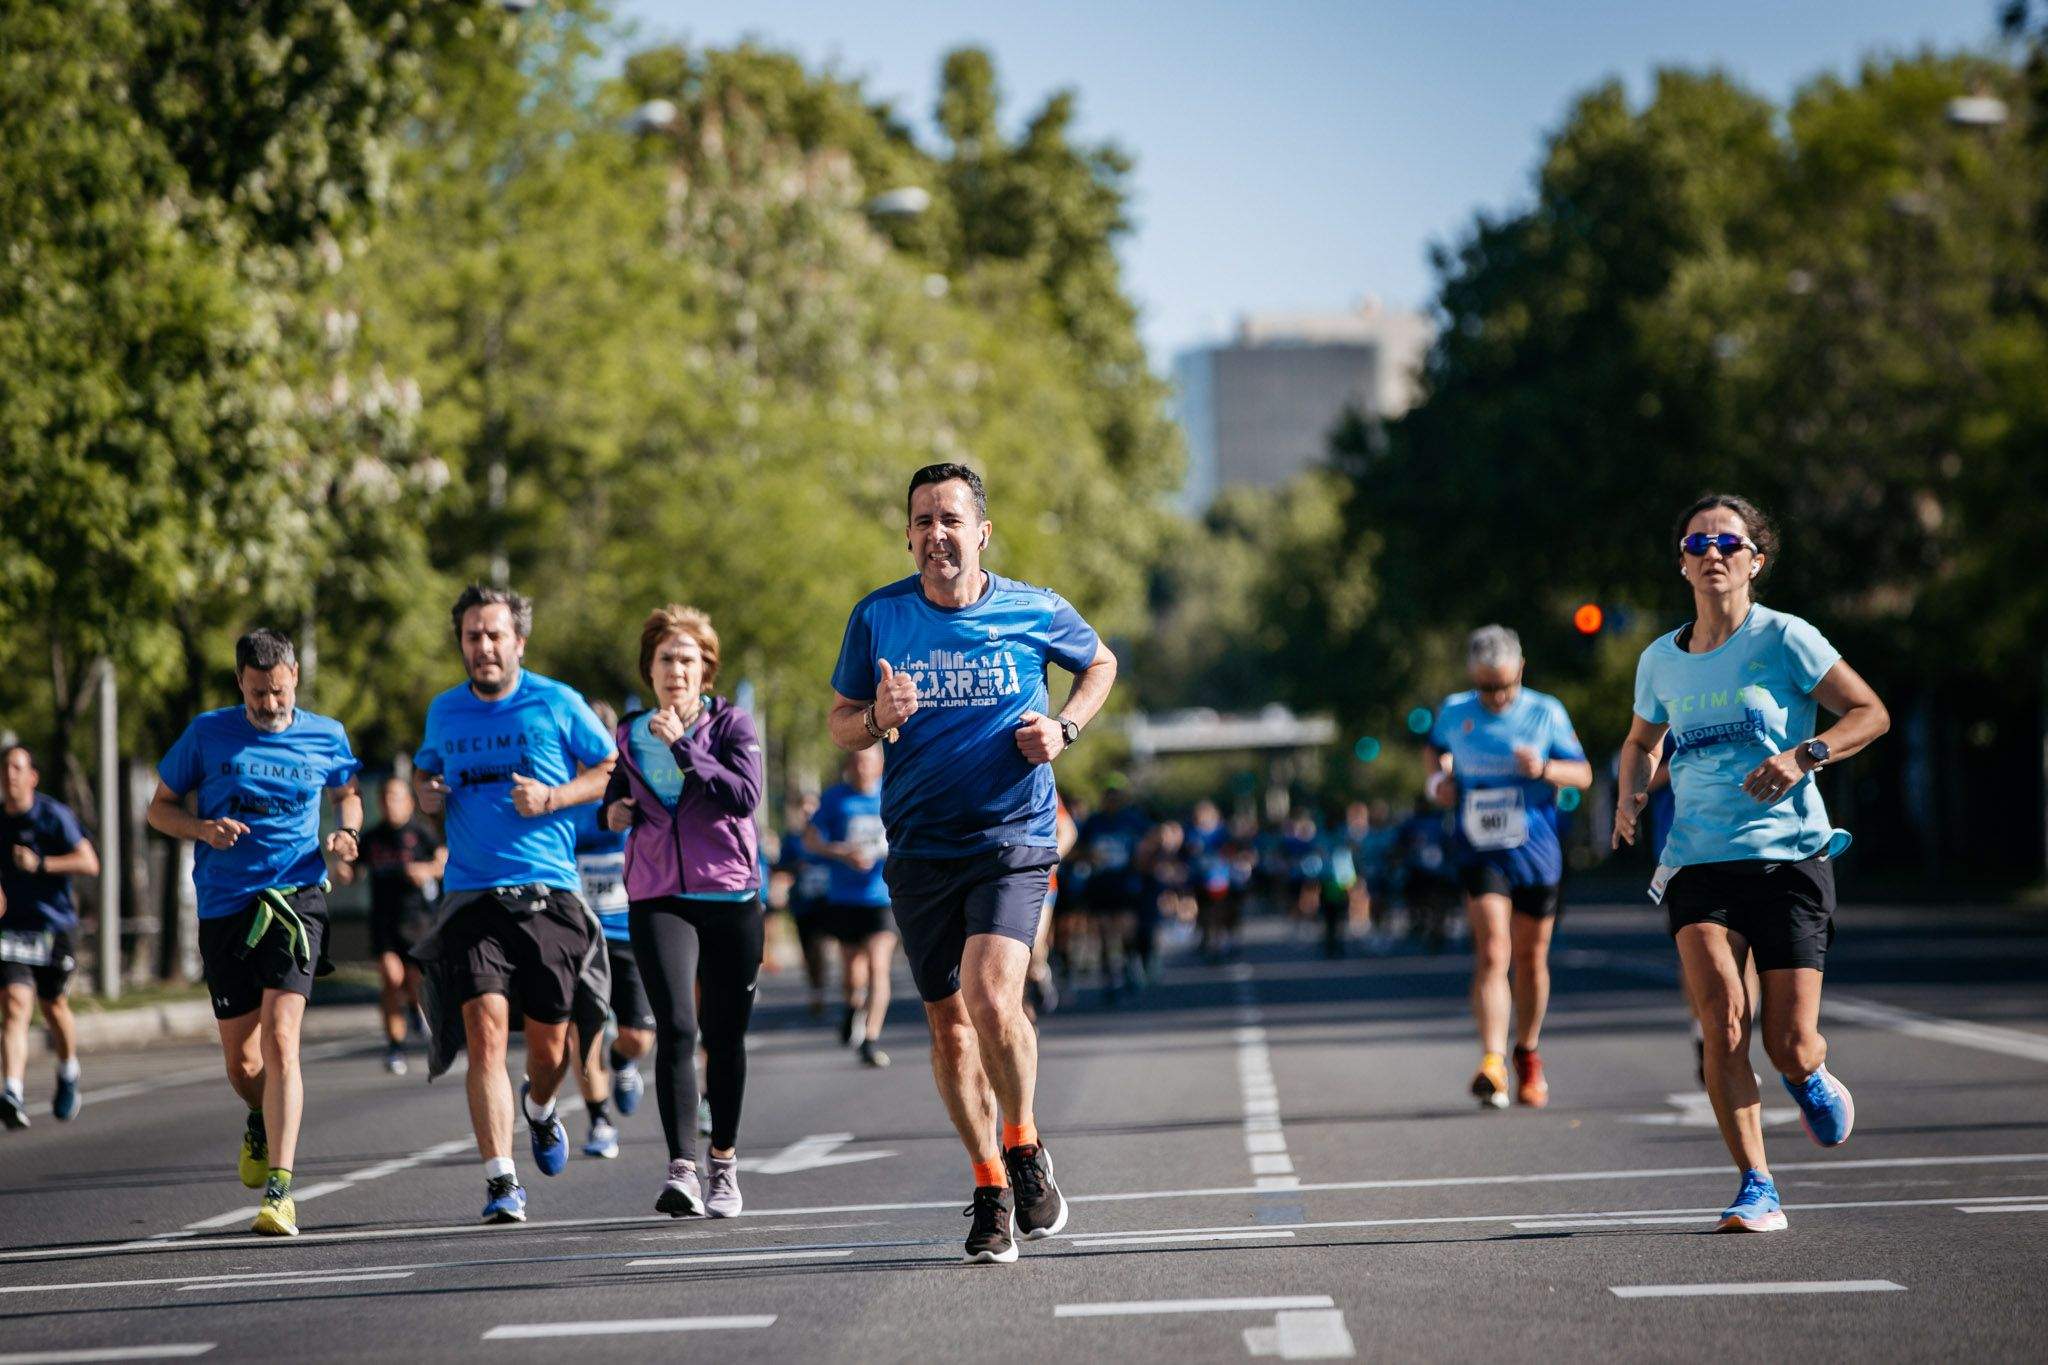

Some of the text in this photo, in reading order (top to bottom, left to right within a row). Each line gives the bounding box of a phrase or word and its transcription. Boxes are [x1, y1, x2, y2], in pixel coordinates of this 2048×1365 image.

[911, 667, 1021, 699] CARRERA
[940, 699, 968, 708] JUAN
[1668, 682, 1767, 713] ECIMA
[1685, 720, 1762, 742] BOMBEROS
[445, 732, 544, 754] DECIMAS
[222, 762, 312, 781] DECIMAS
